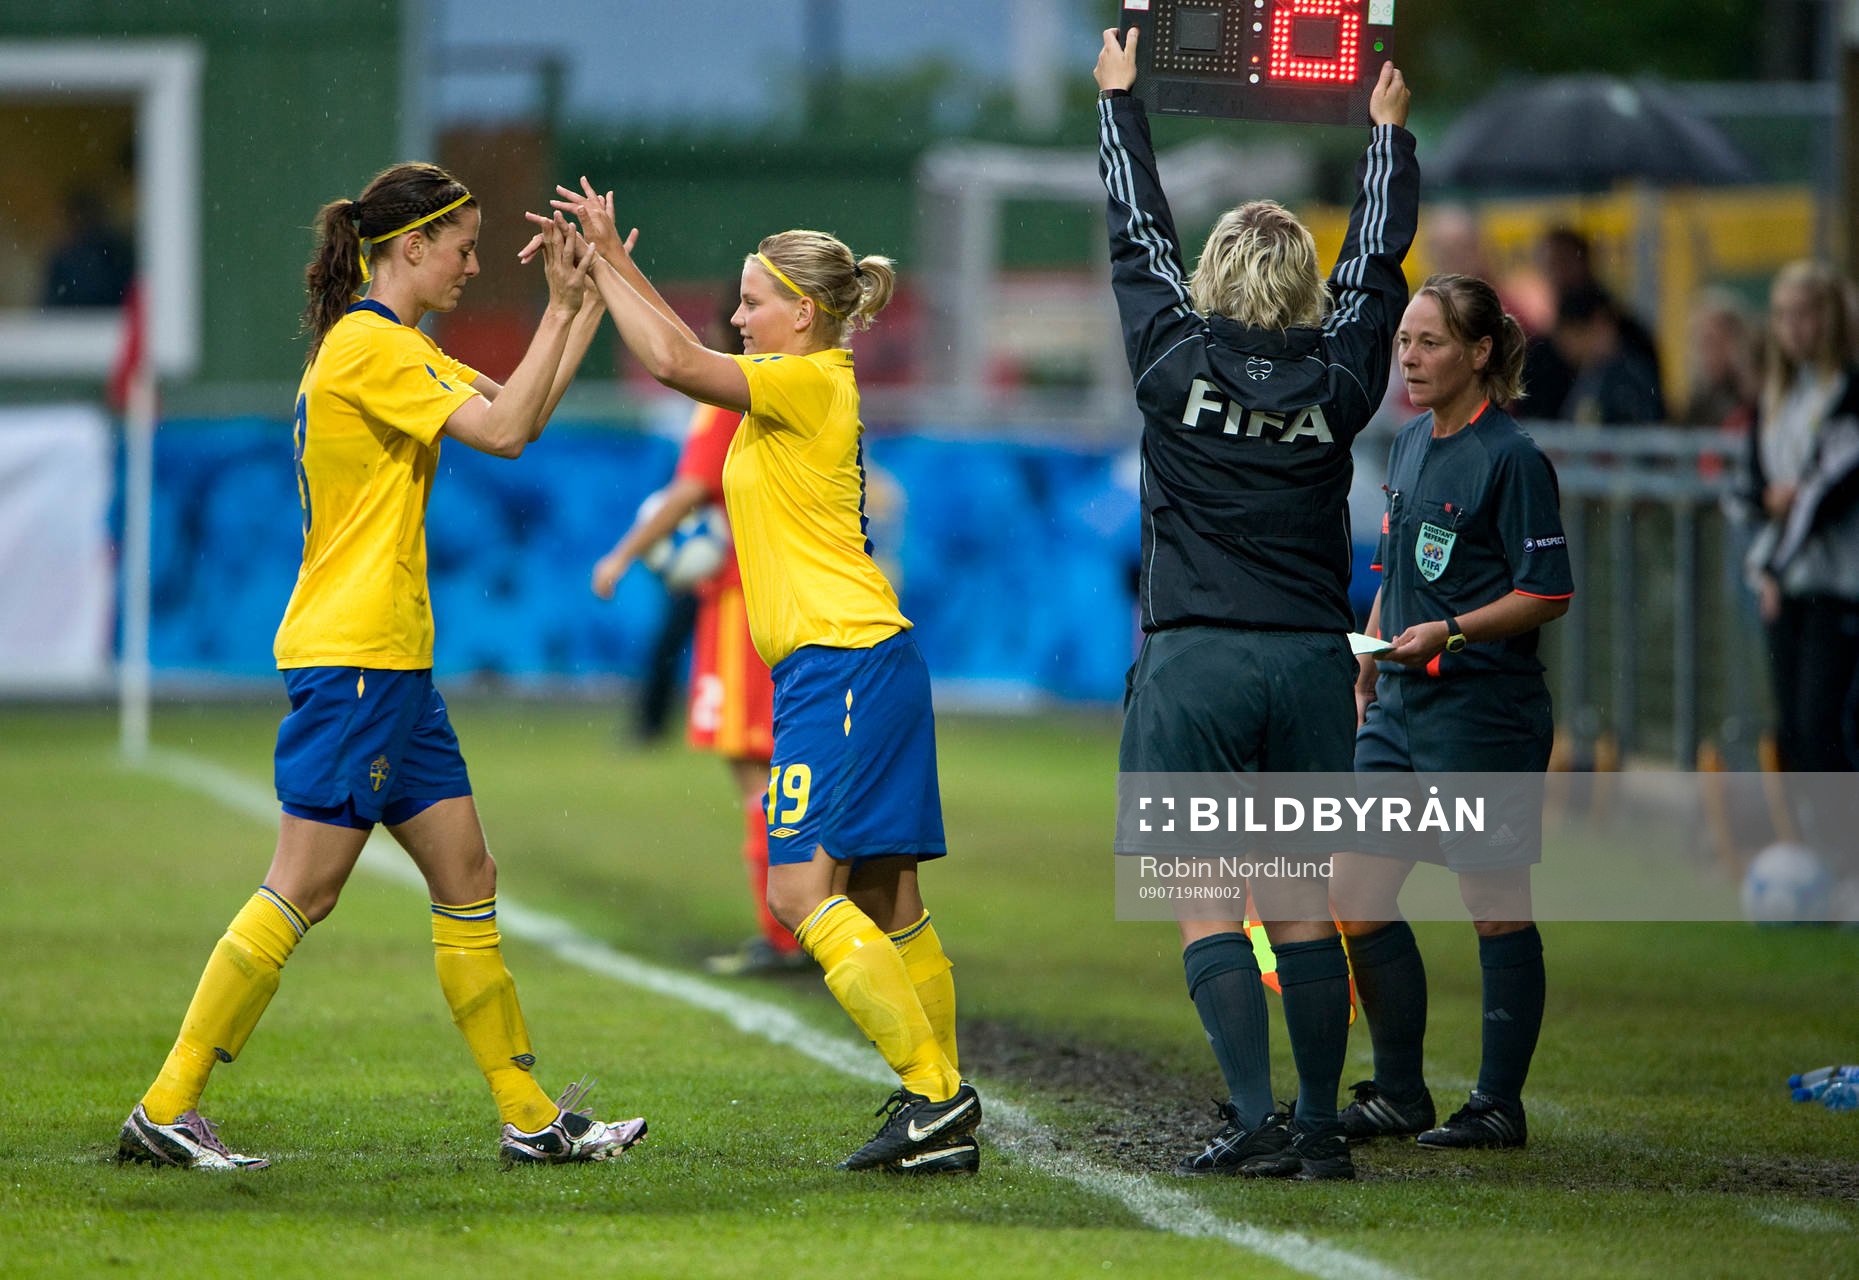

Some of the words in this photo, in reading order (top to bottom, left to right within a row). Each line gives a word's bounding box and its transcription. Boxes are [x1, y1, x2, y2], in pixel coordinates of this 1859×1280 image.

[1182, 379, 1334, 443] FIFA
[1423, 524, 1455, 540] ASSISTANT
[1423, 532, 1449, 546] REFEREE
[1536, 536, 1565, 548] RESPECT
[1421, 558, 1441, 572] FIFA
[767, 763, 812, 825] 19
